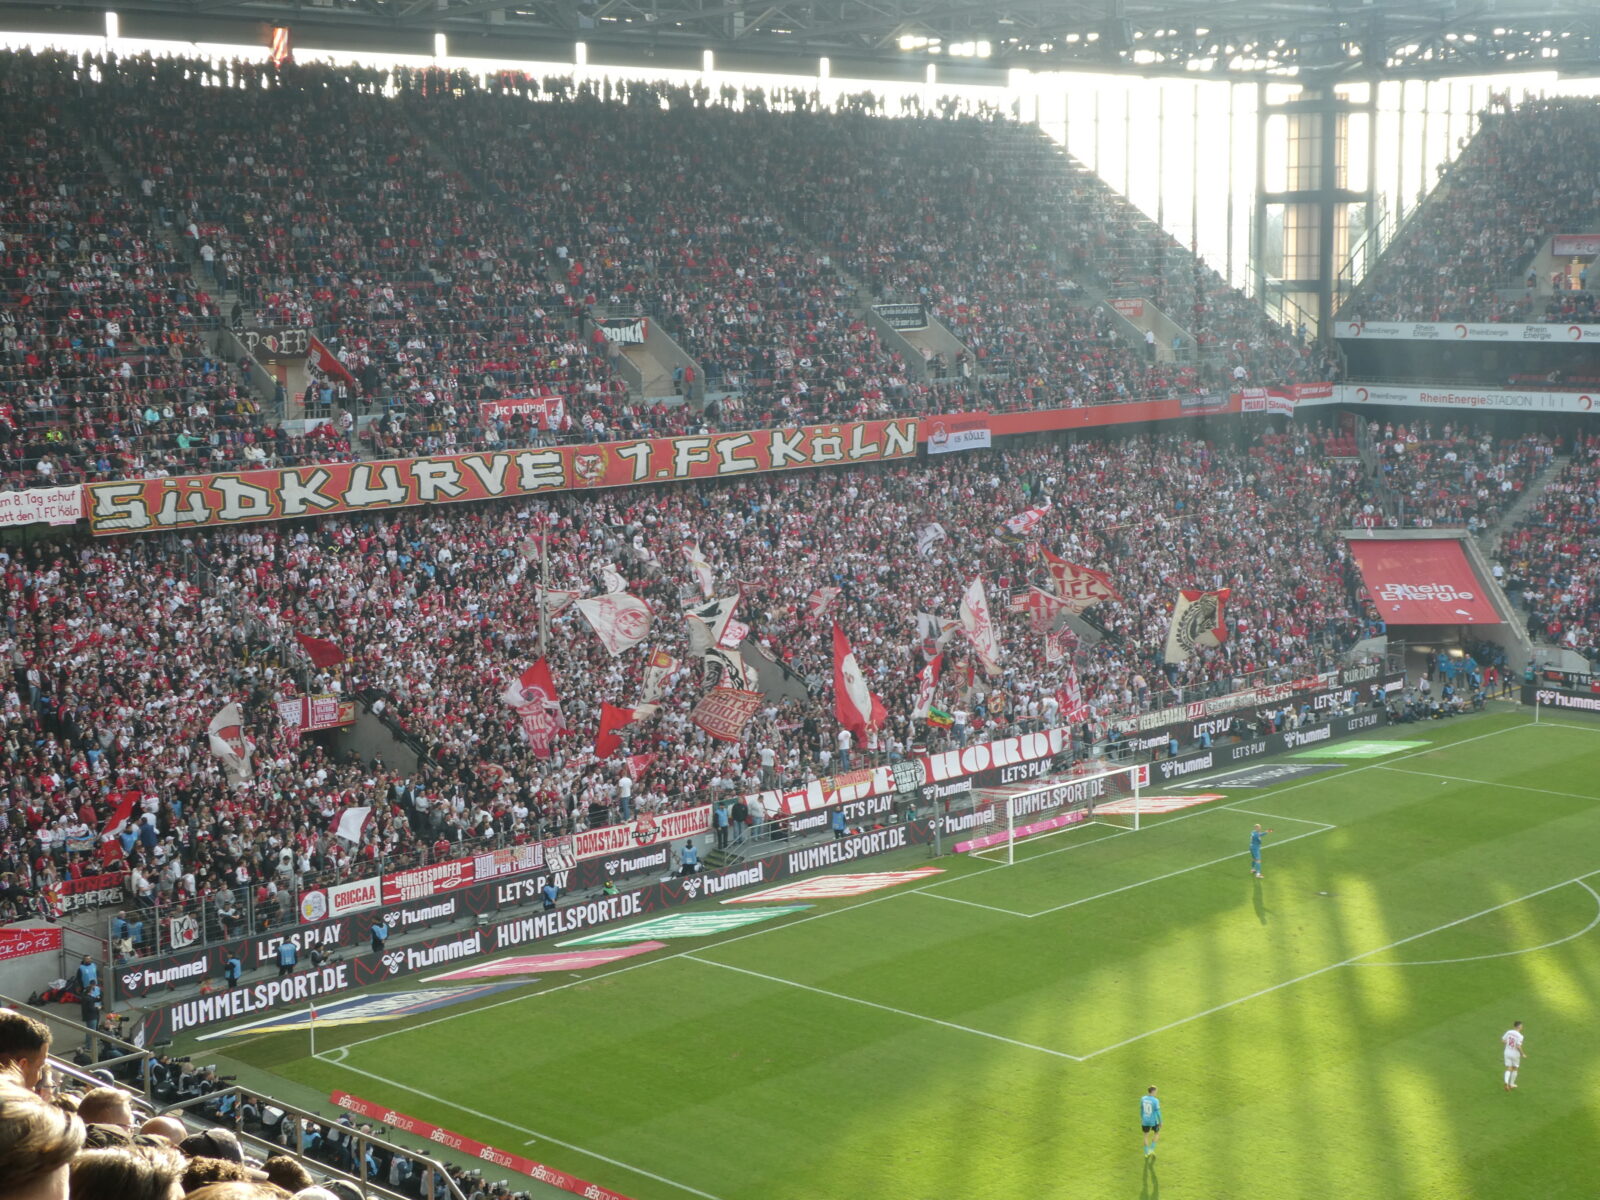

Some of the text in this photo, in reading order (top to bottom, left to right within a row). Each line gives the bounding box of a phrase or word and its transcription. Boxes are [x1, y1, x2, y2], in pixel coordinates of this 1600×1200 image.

[769, 422, 917, 467] KÖLN
[25, 493, 43, 506] Tag
[47, 489, 76, 502] schuf
[93, 451, 566, 529] SÜDKURVE
[17, 510, 34, 521] den
[44, 506, 57, 518] FC
[58, 506, 80, 516] Köln
[1380, 591, 1474, 602] Energie
[1384, 583, 1455, 593] Rhein
[1364, 714, 1378, 727] PLAY
[1138, 731, 1170, 750] hummel
[1296, 724, 1331, 745] hummel
[930, 726, 1073, 780] HORDE
[1233, 741, 1266, 759] LET'S PLAY
[1001, 758, 1054, 784] LET'S PLAY
[1173, 752, 1213, 776] hummel
[935, 777, 972, 798] hummel
[843, 794, 893, 820] ET'S PLAY
[945, 805, 996, 833] hummel
[576, 826, 631, 857] DOMSTADT
[660, 807, 711, 838] SYNDIKAT
[620, 849, 667, 873] hummel
[789, 827, 907, 874] HUMMELSPORT.DE
[498, 871, 568, 903] LET'S PAY
[703, 862, 764, 895] hummel
[334, 885, 377, 908] CRICCAA
[401, 881, 434, 901] STADION
[402, 898, 455, 925] hummel
[497, 892, 643, 947] HUMMELSPORT.DE
[407, 931, 482, 970] hummel
[144, 956, 208, 988] hummel
[171, 964, 349, 1033] HUMMELSPORT.DE
[338, 1096, 368, 1115] DERTOUR
[384, 1112, 414, 1132] DERTOUR
[430, 1129, 462, 1149] DERTOUR
[479, 1147, 513, 1168] DERTOUR
[530, 1165, 565, 1187] DERTOUR
